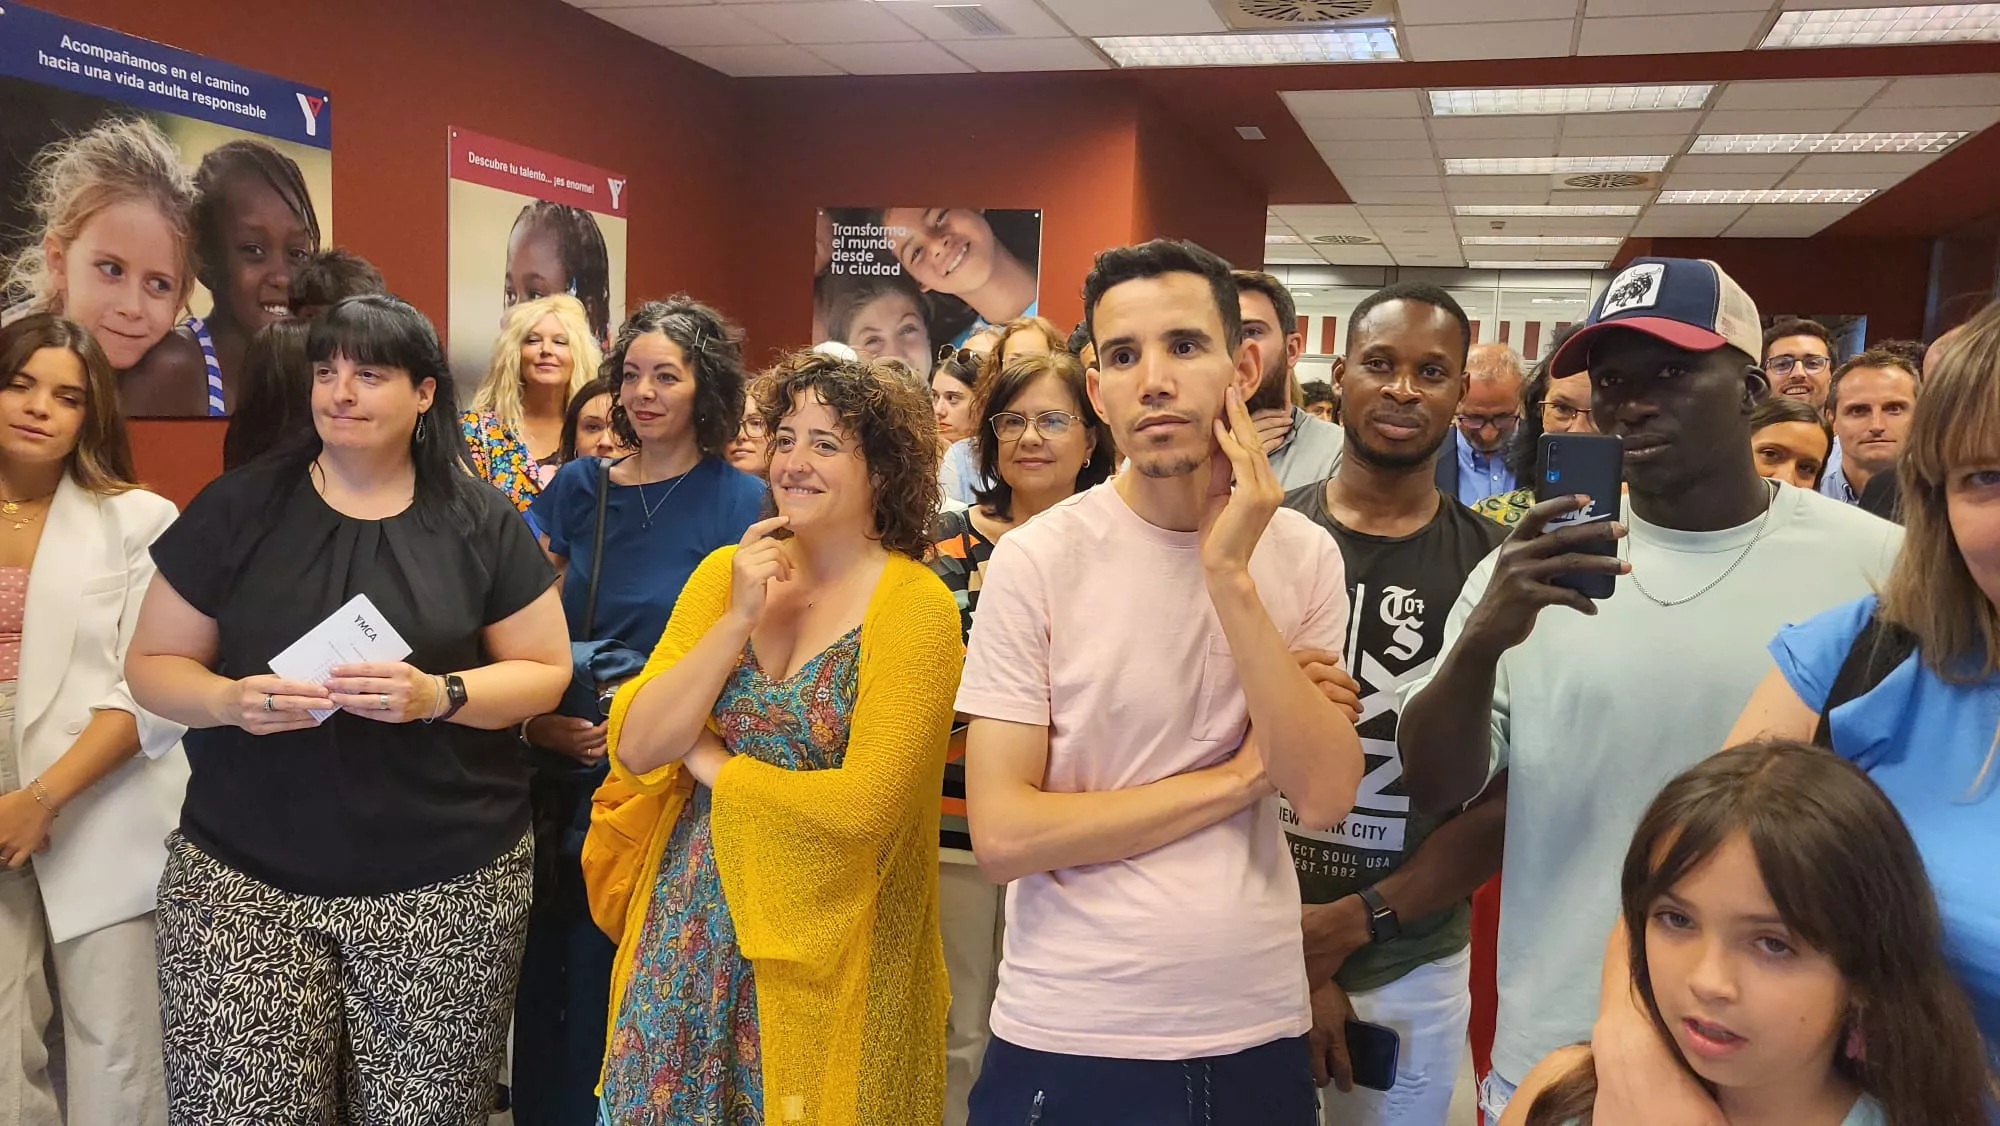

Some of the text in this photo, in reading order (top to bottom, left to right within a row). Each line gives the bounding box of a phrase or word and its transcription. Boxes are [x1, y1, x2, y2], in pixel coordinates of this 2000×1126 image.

[60, 34, 250, 97] Acompañamos en el camino
[38, 49, 267, 120] hacia una vida adulta responsable
[468, 151, 595, 195] Descubre tu talento... ¡es enorme!
[832, 223, 907, 237] Transforma
[832, 236, 897, 250] el mundo
[831, 249, 875, 262] desde
[831, 262, 901, 276] tu ciudad
[353, 614, 378, 642] YMCA
[1351, 822, 1388, 841] CITY
[1322, 849, 1359, 866] SOUL
[1366, 856, 1391, 869] USA
